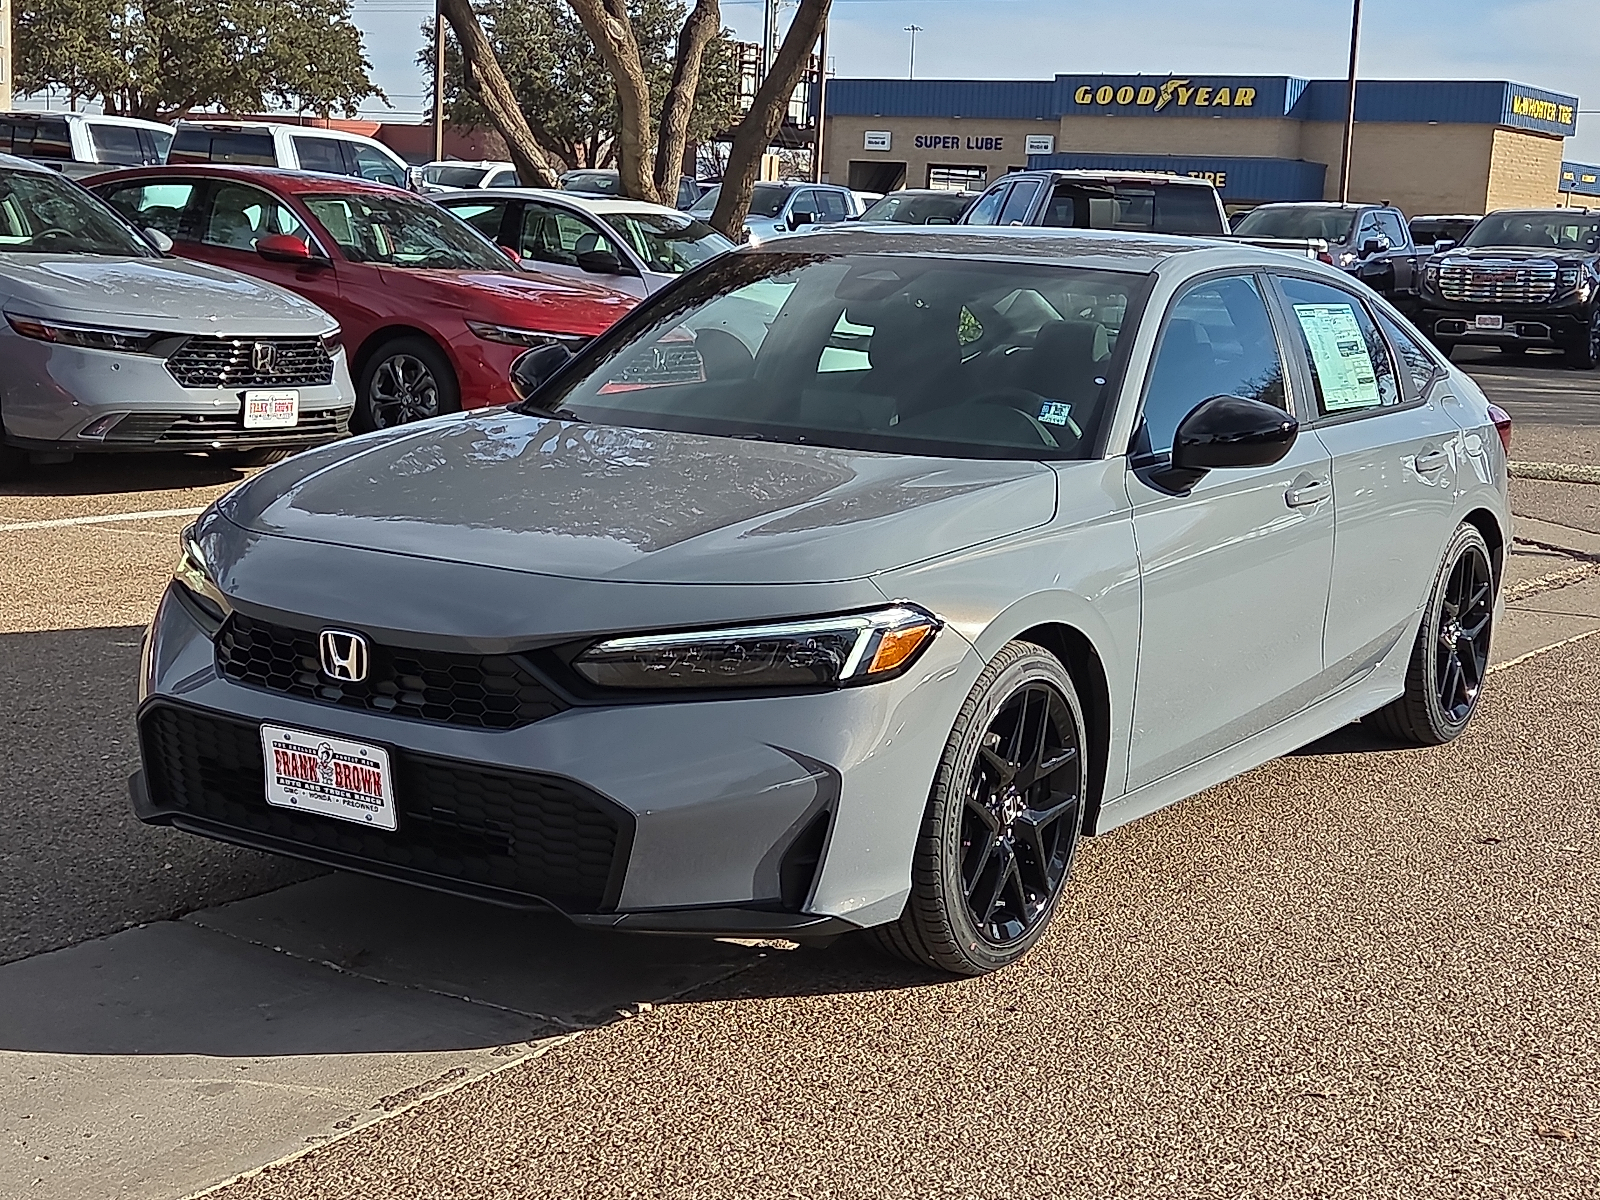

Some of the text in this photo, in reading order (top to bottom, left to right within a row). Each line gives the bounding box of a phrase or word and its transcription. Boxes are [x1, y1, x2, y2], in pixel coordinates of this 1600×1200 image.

[914, 135, 1004, 151] SUPER LUBE
[273, 749, 383, 798] FRANK BROWN
[279, 778, 382, 806] AUTO AND TRUCK RANCH
[308, 791, 333, 803] HONDA
[342, 799, 379, 813] PREOWNED
